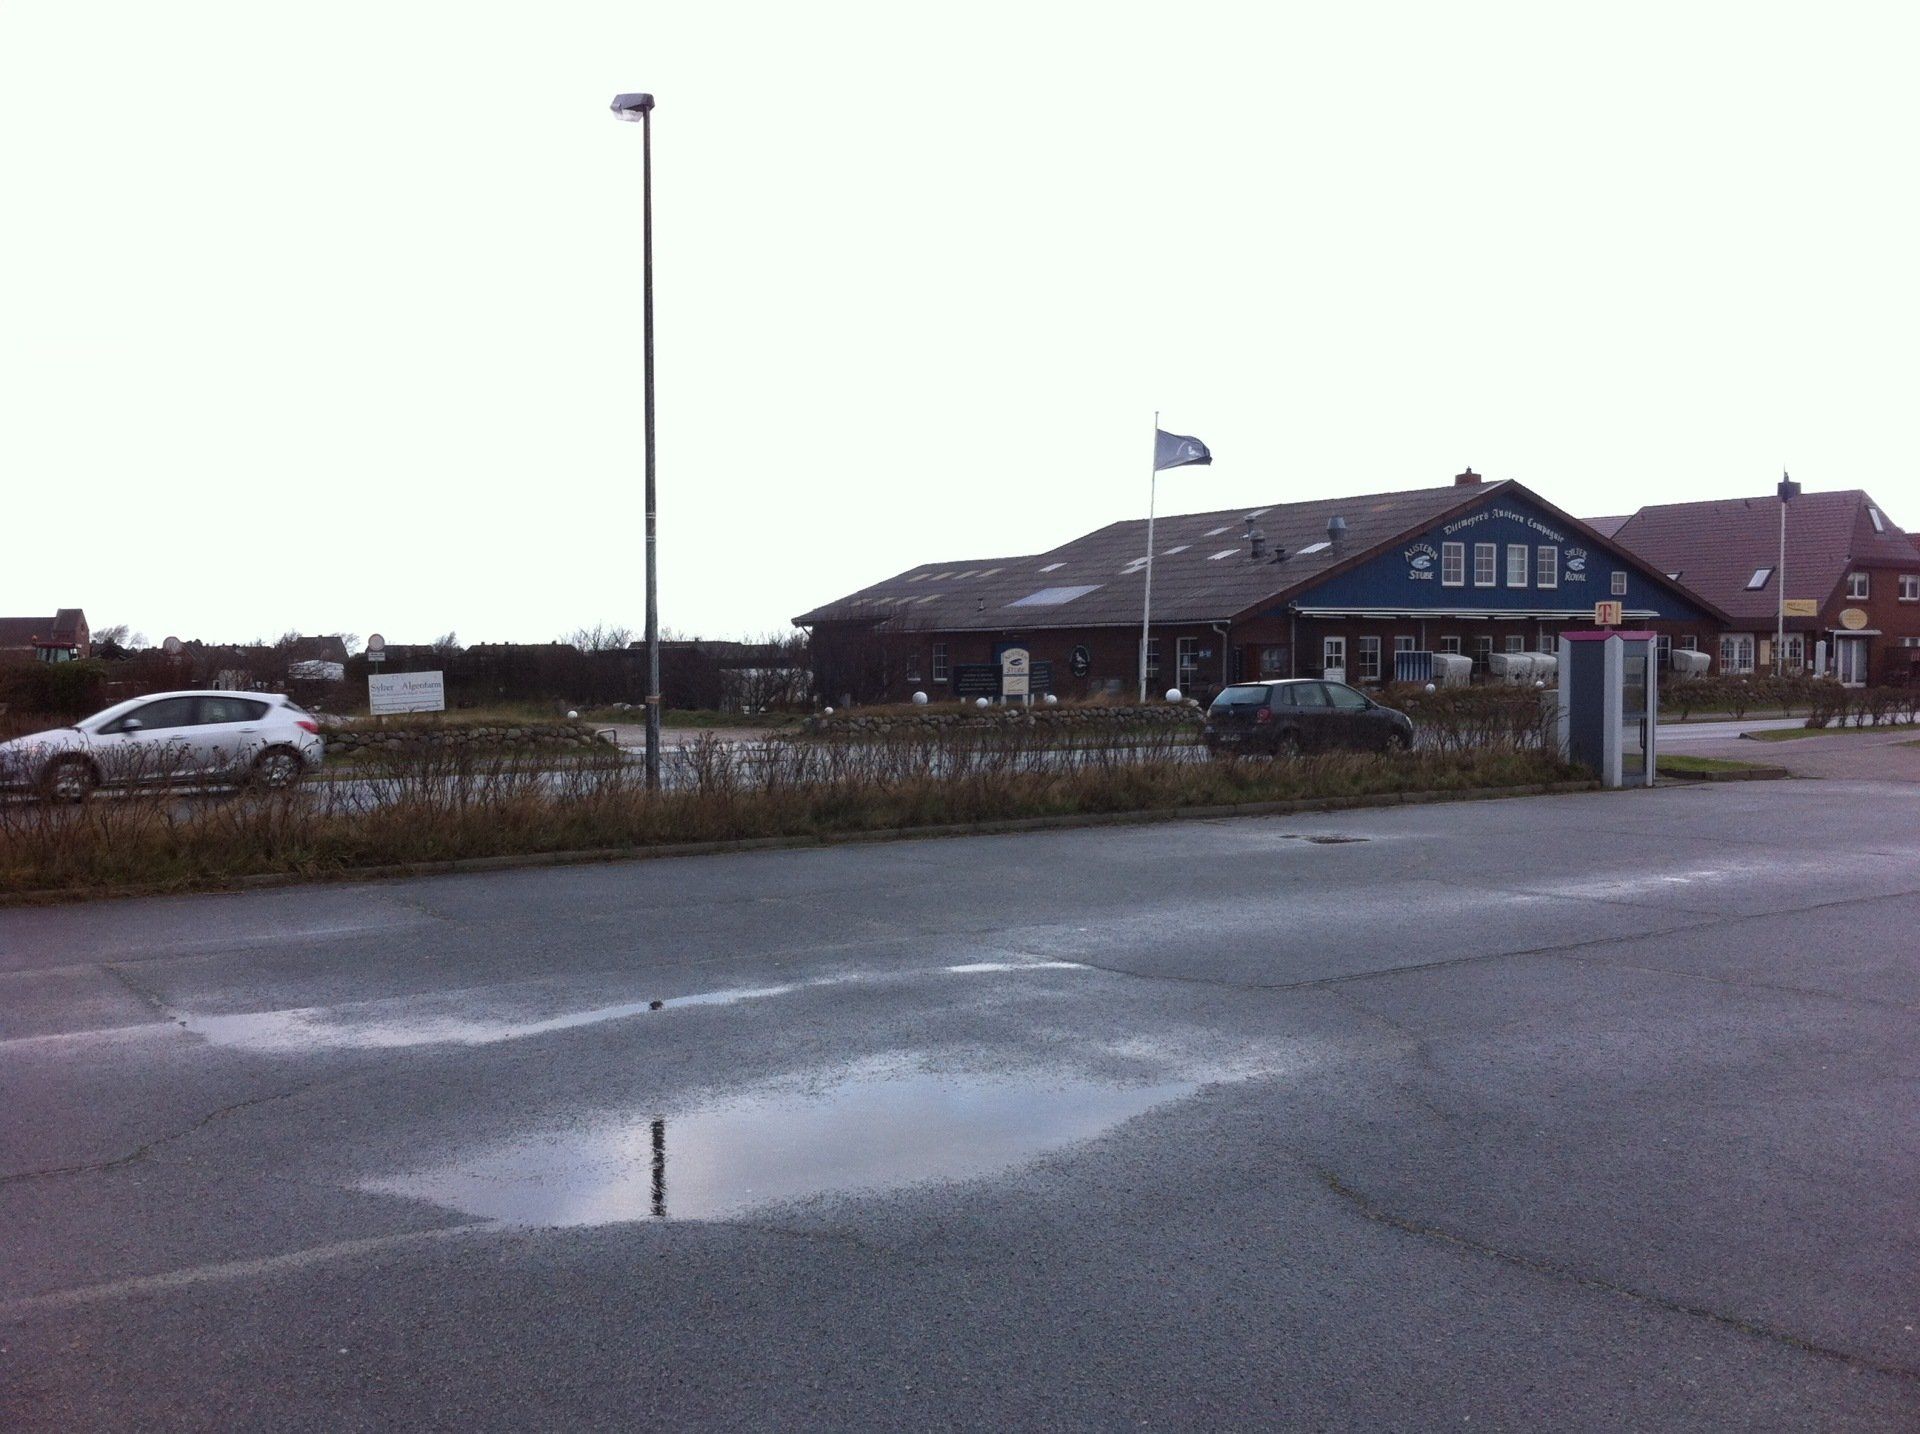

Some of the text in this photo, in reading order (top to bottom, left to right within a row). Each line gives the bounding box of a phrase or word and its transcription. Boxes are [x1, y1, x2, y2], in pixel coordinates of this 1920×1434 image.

[1443, 508, 1565, 543] Dittmeyer's Austern Compagnie
[1404, 543, 1438, 560] AUSTERN
[1564, 547, 1588, 559] SYLTER
[1408, 570, 1435, 580] STUBE
[1564, 571, 1587, 582] ROYAL
